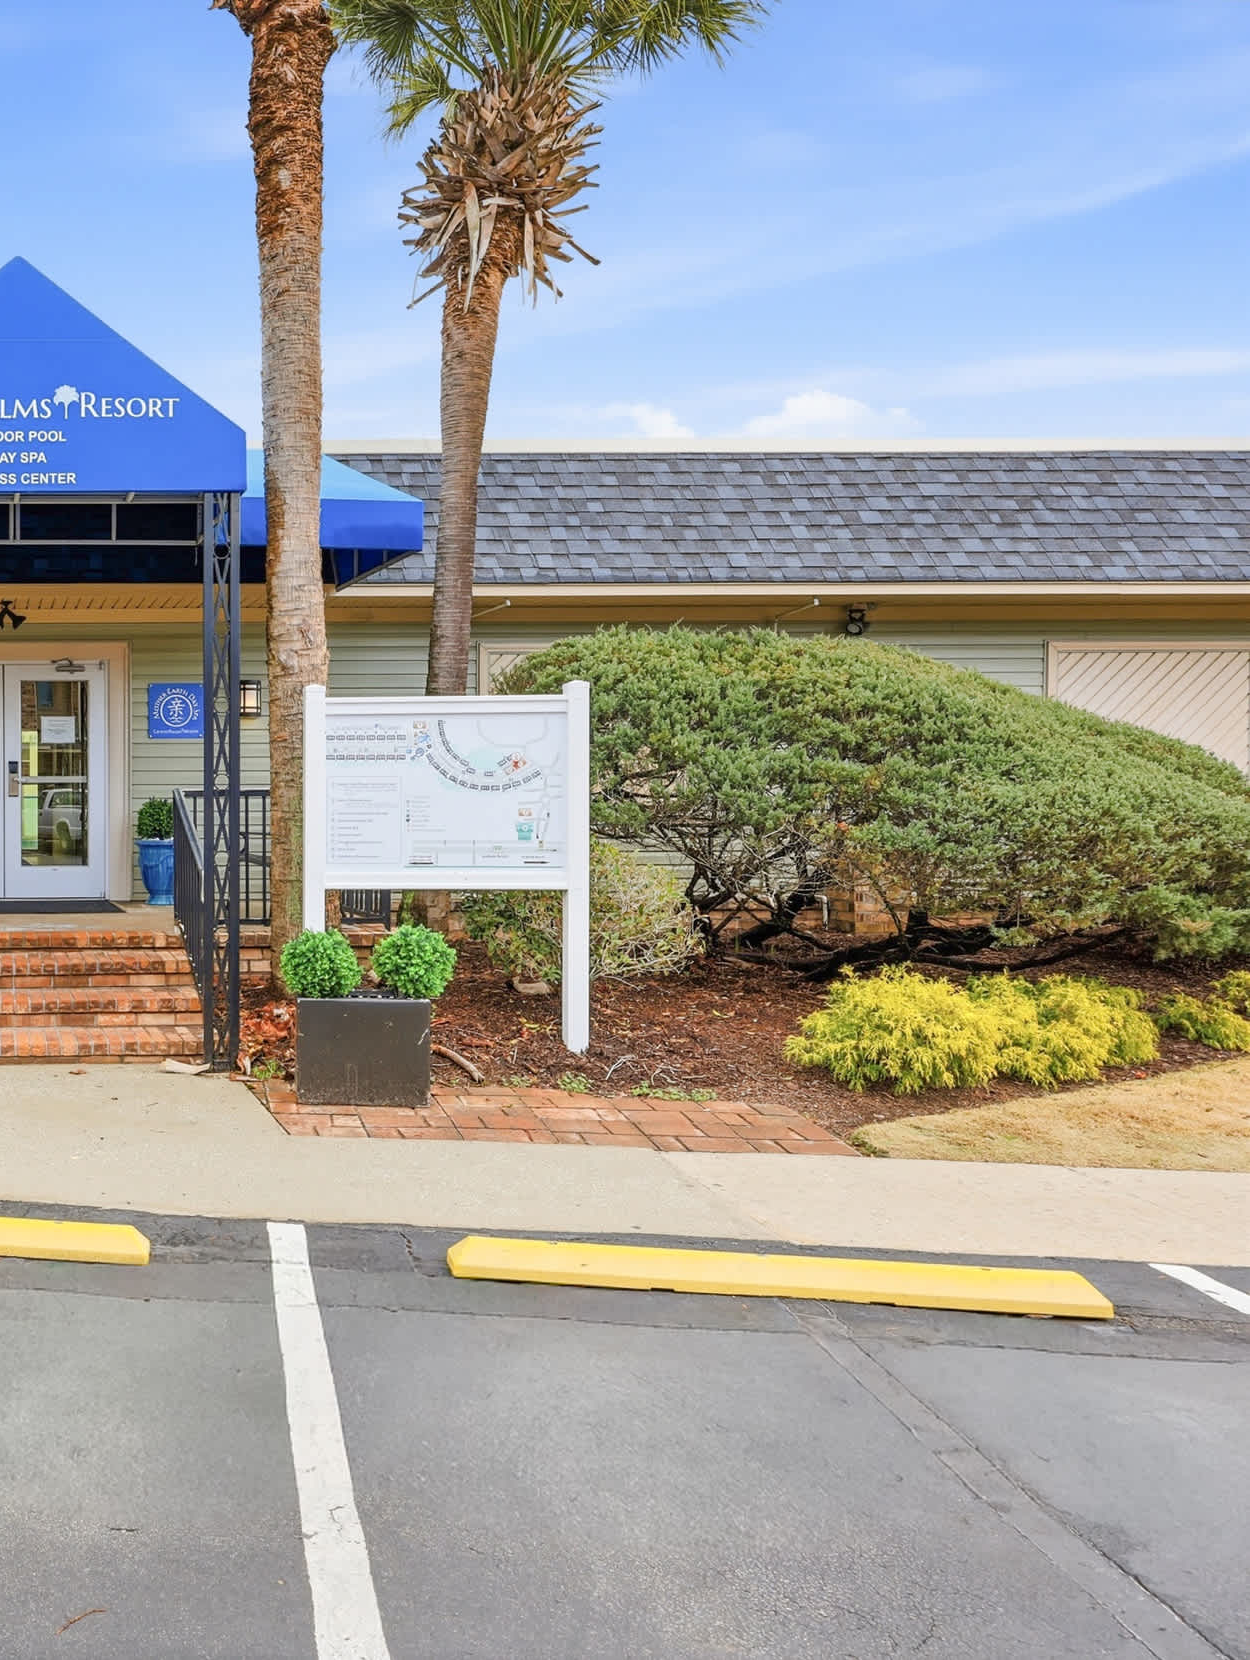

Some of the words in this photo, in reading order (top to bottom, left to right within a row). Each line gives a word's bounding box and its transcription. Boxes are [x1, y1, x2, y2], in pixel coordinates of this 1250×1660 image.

[79, 391, 181, 419] RESORT
[28, 430, 67, 443] POOL
[20, 451, 47, 464] SPA
[20, 472, 76, 486] CENTER
